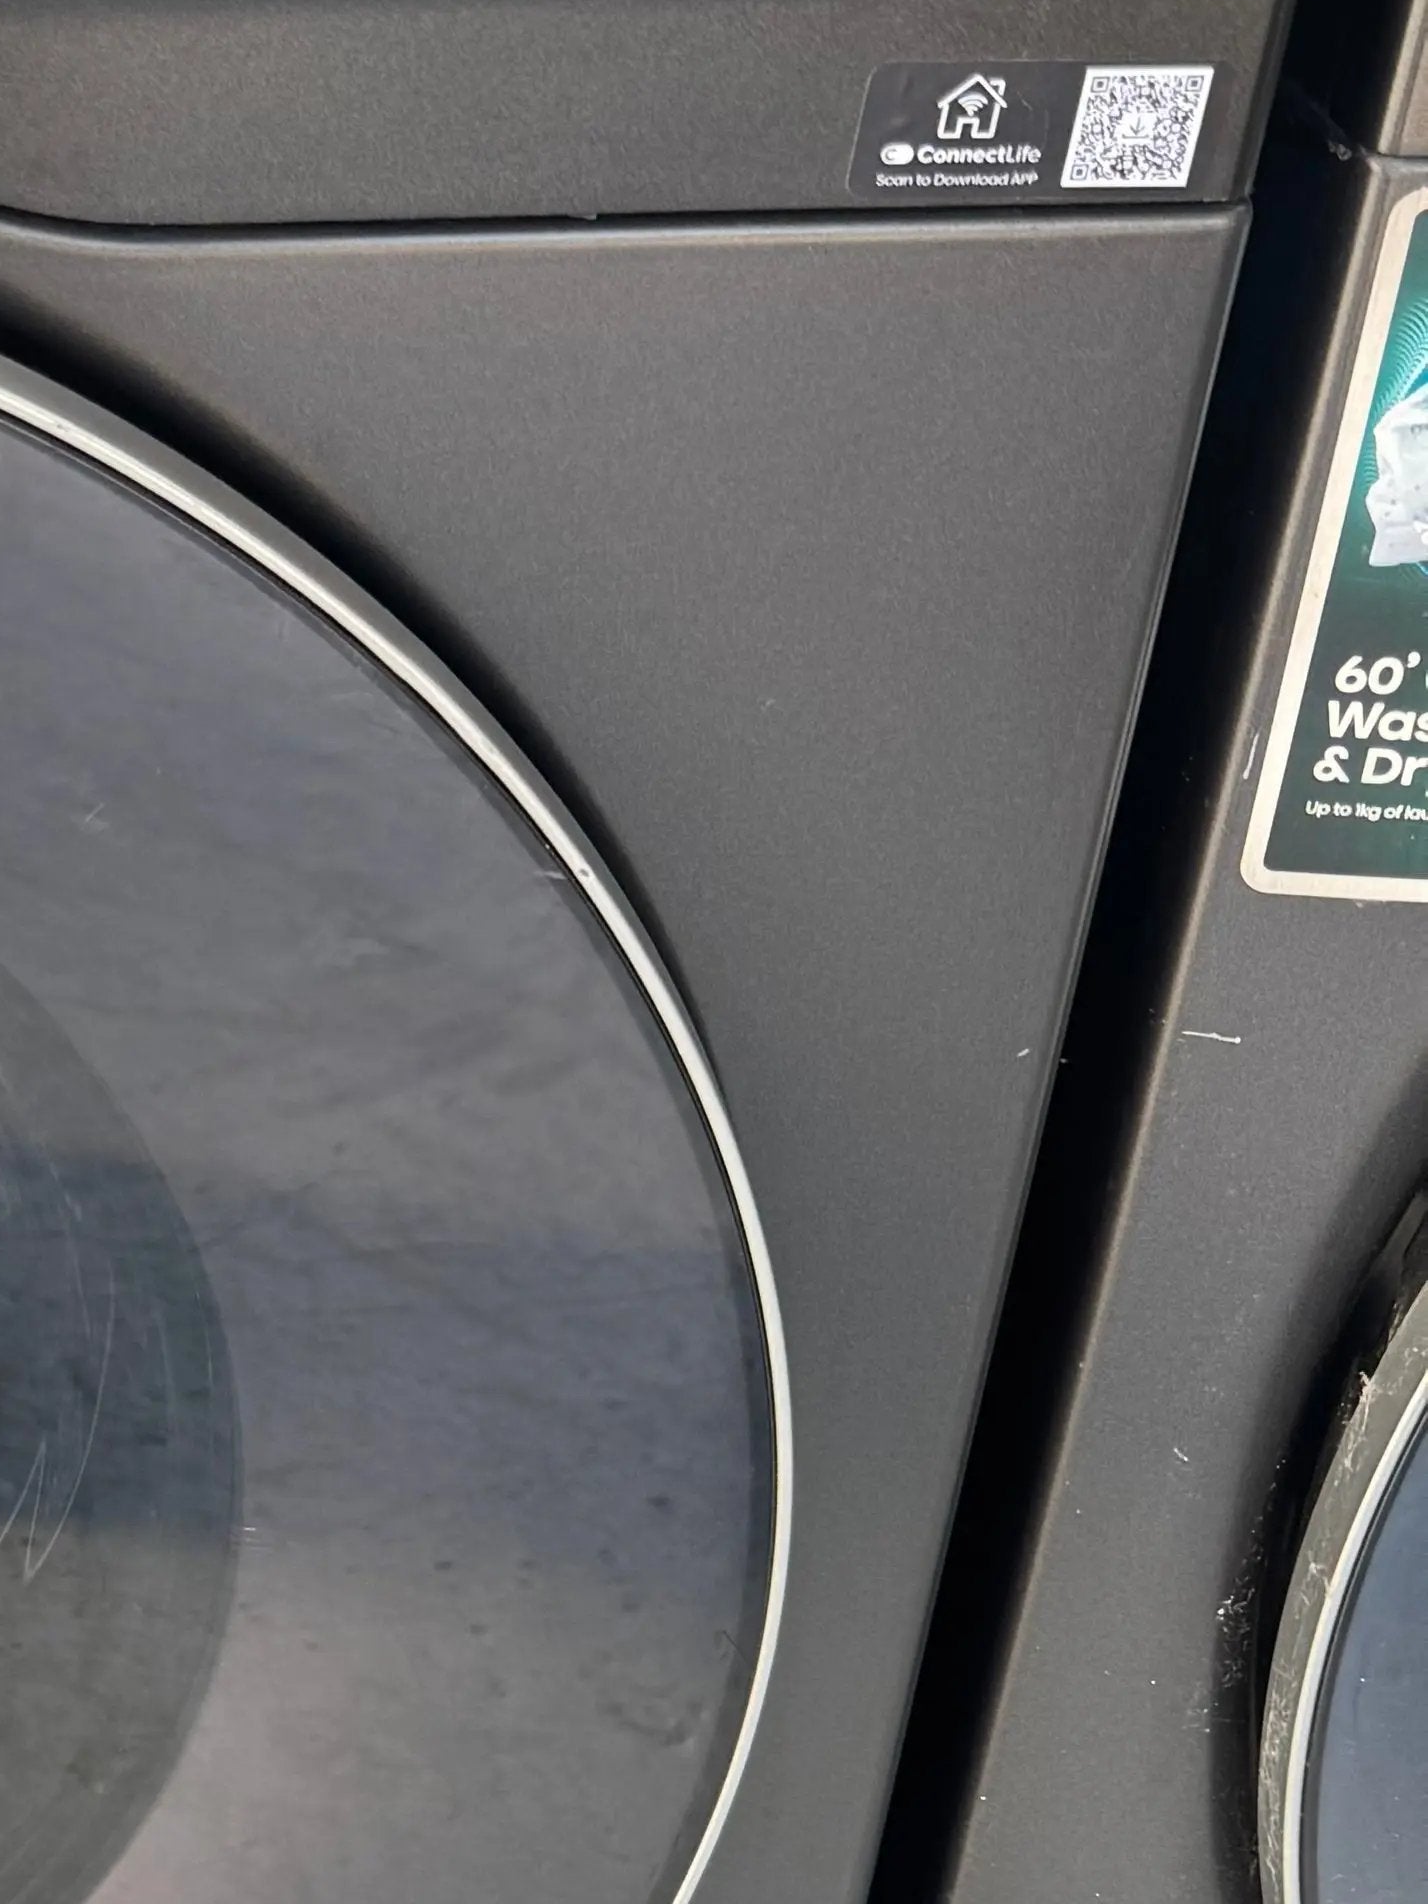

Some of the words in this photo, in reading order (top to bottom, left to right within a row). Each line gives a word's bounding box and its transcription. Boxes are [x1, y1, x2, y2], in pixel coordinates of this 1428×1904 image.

[916, 143, 1043, 165] ConnectLife
[875, 171, 914, 187] Scan
[916, 172, 932, 187] to
[933, 171, 1009, 187] Download
[1312, 745, 1351, 784] &
[1360, 747, 1428, 797] Dr
[1305, 799, 1331, 819] Up
[1332, 801, 1354, 818] to
[1355, 802, 1383, 823] 1kg
[1383, 803, 1403, 820] of
